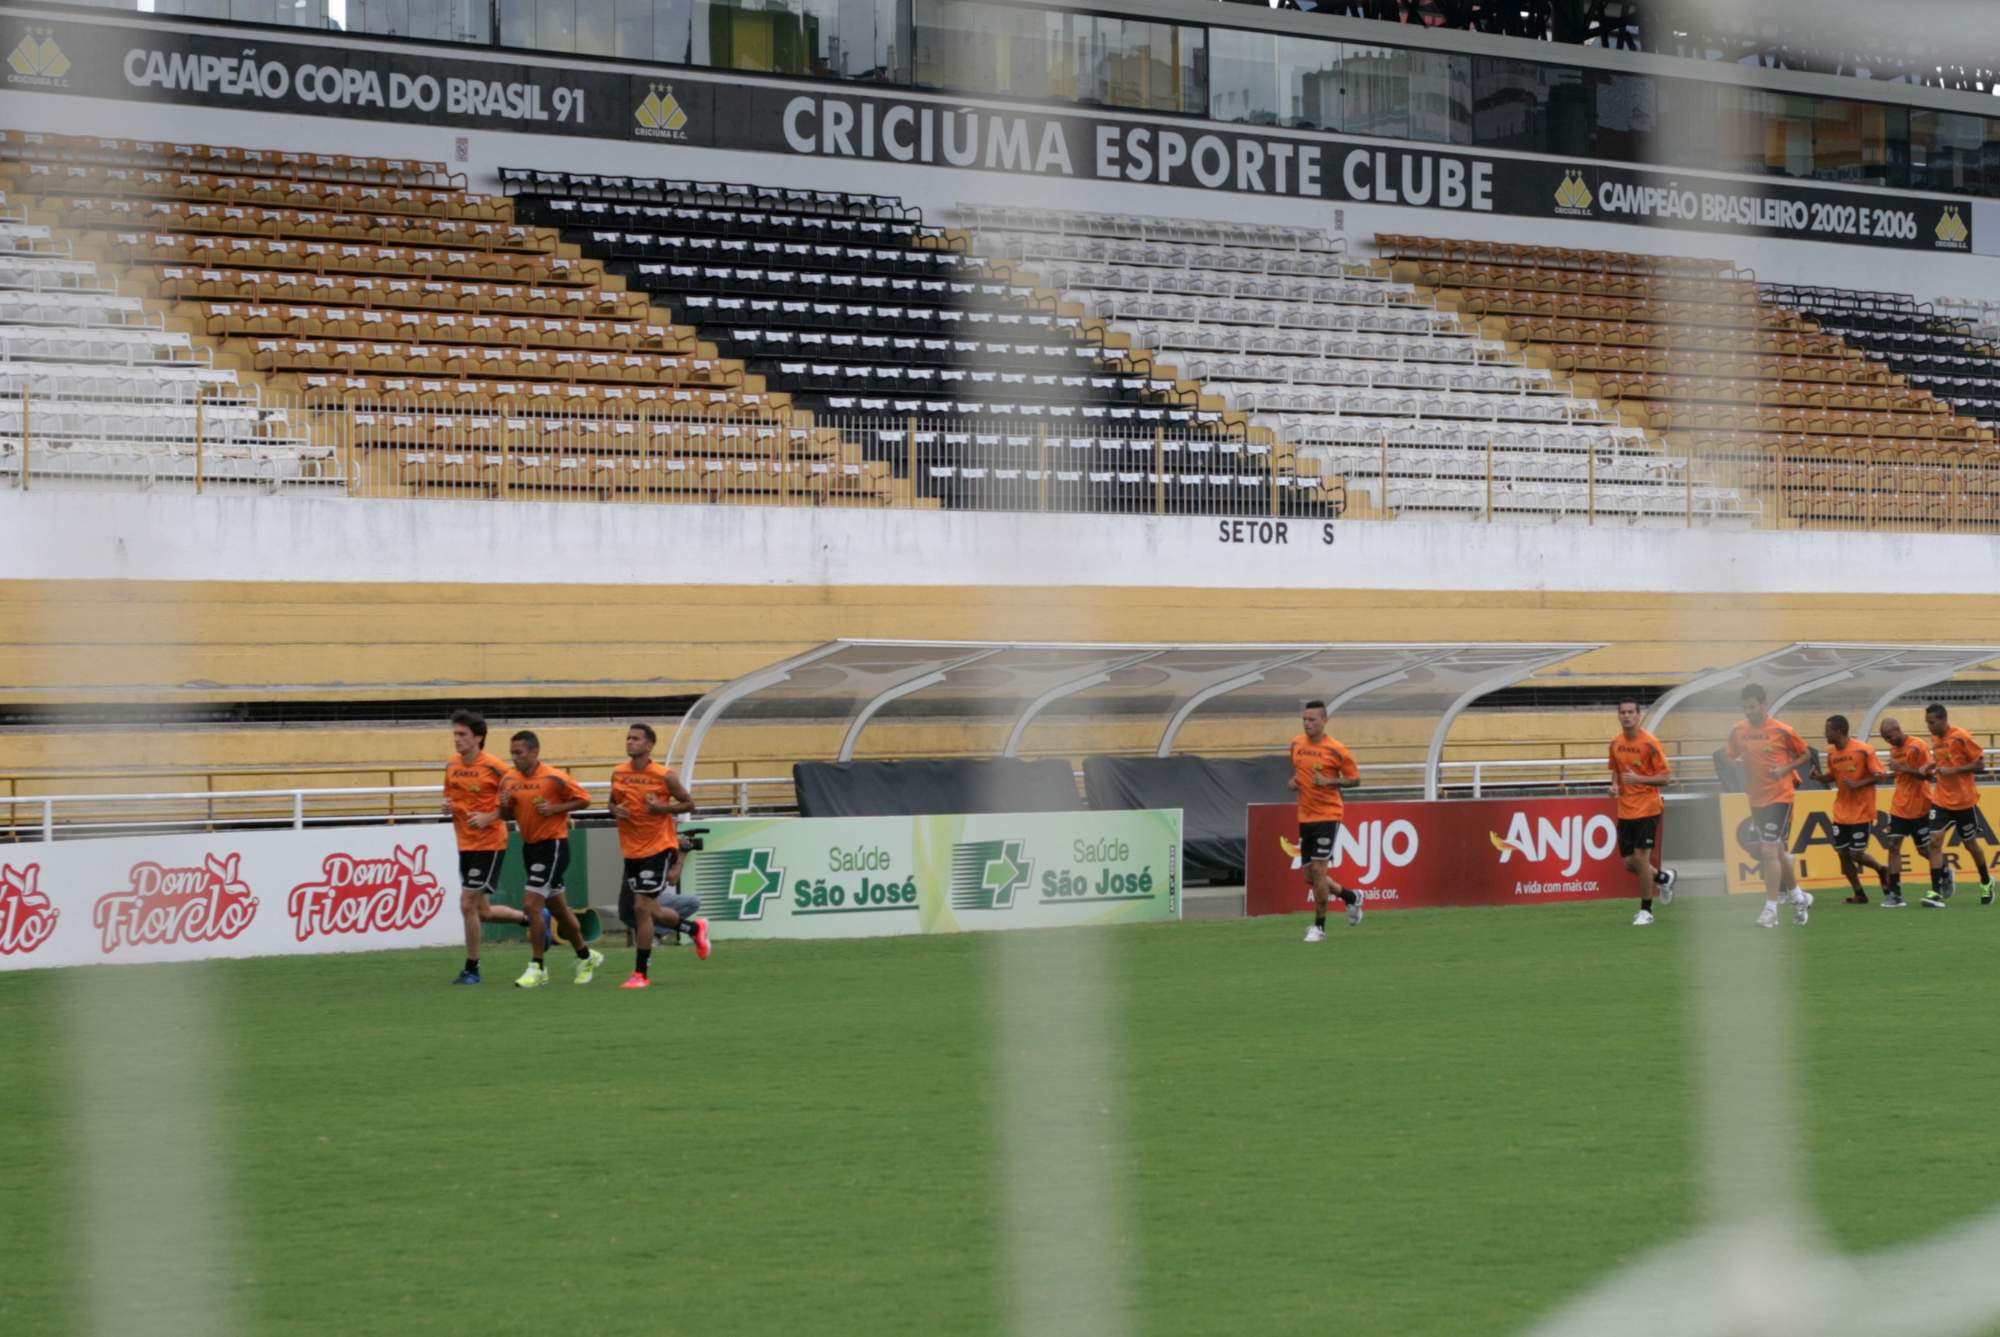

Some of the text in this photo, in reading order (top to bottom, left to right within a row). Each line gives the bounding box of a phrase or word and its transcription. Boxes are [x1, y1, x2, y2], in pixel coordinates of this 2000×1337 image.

[123, 48, 585, 123] CAMPEÃO COPA DO BRASIL 91
[782, 96, 1493, 211] CRICIÚMA ESPORTE CLUBE
[1599, 181, 1918, 240] CAMPEÃO BRASILEIRO 2002 E 2006
[1219, 520, 1334, 545] SETOR S
[829, 845, 890, 872] Saúde
[1073, 836, 1129, 864] Saúde
[1499, 812, 1617, 877] ANJO
[133, 866, 209, 896] Dom
[326, 857, 400, 887] Dom
[1041, 869, 1087, 898] São
[1095, 866, 1153, 895] José
[1515, 882, 1522, 895] A
[1523, 881, 1541, 894] vida
[1543, 883, 1561, 893] com
[1563, 880, 1581, 892] mais
[292, 876, 445, 939] Fiorelo
[794, 875, 917, 908] São José
[97, 885, 258, 949] Fiorelo
